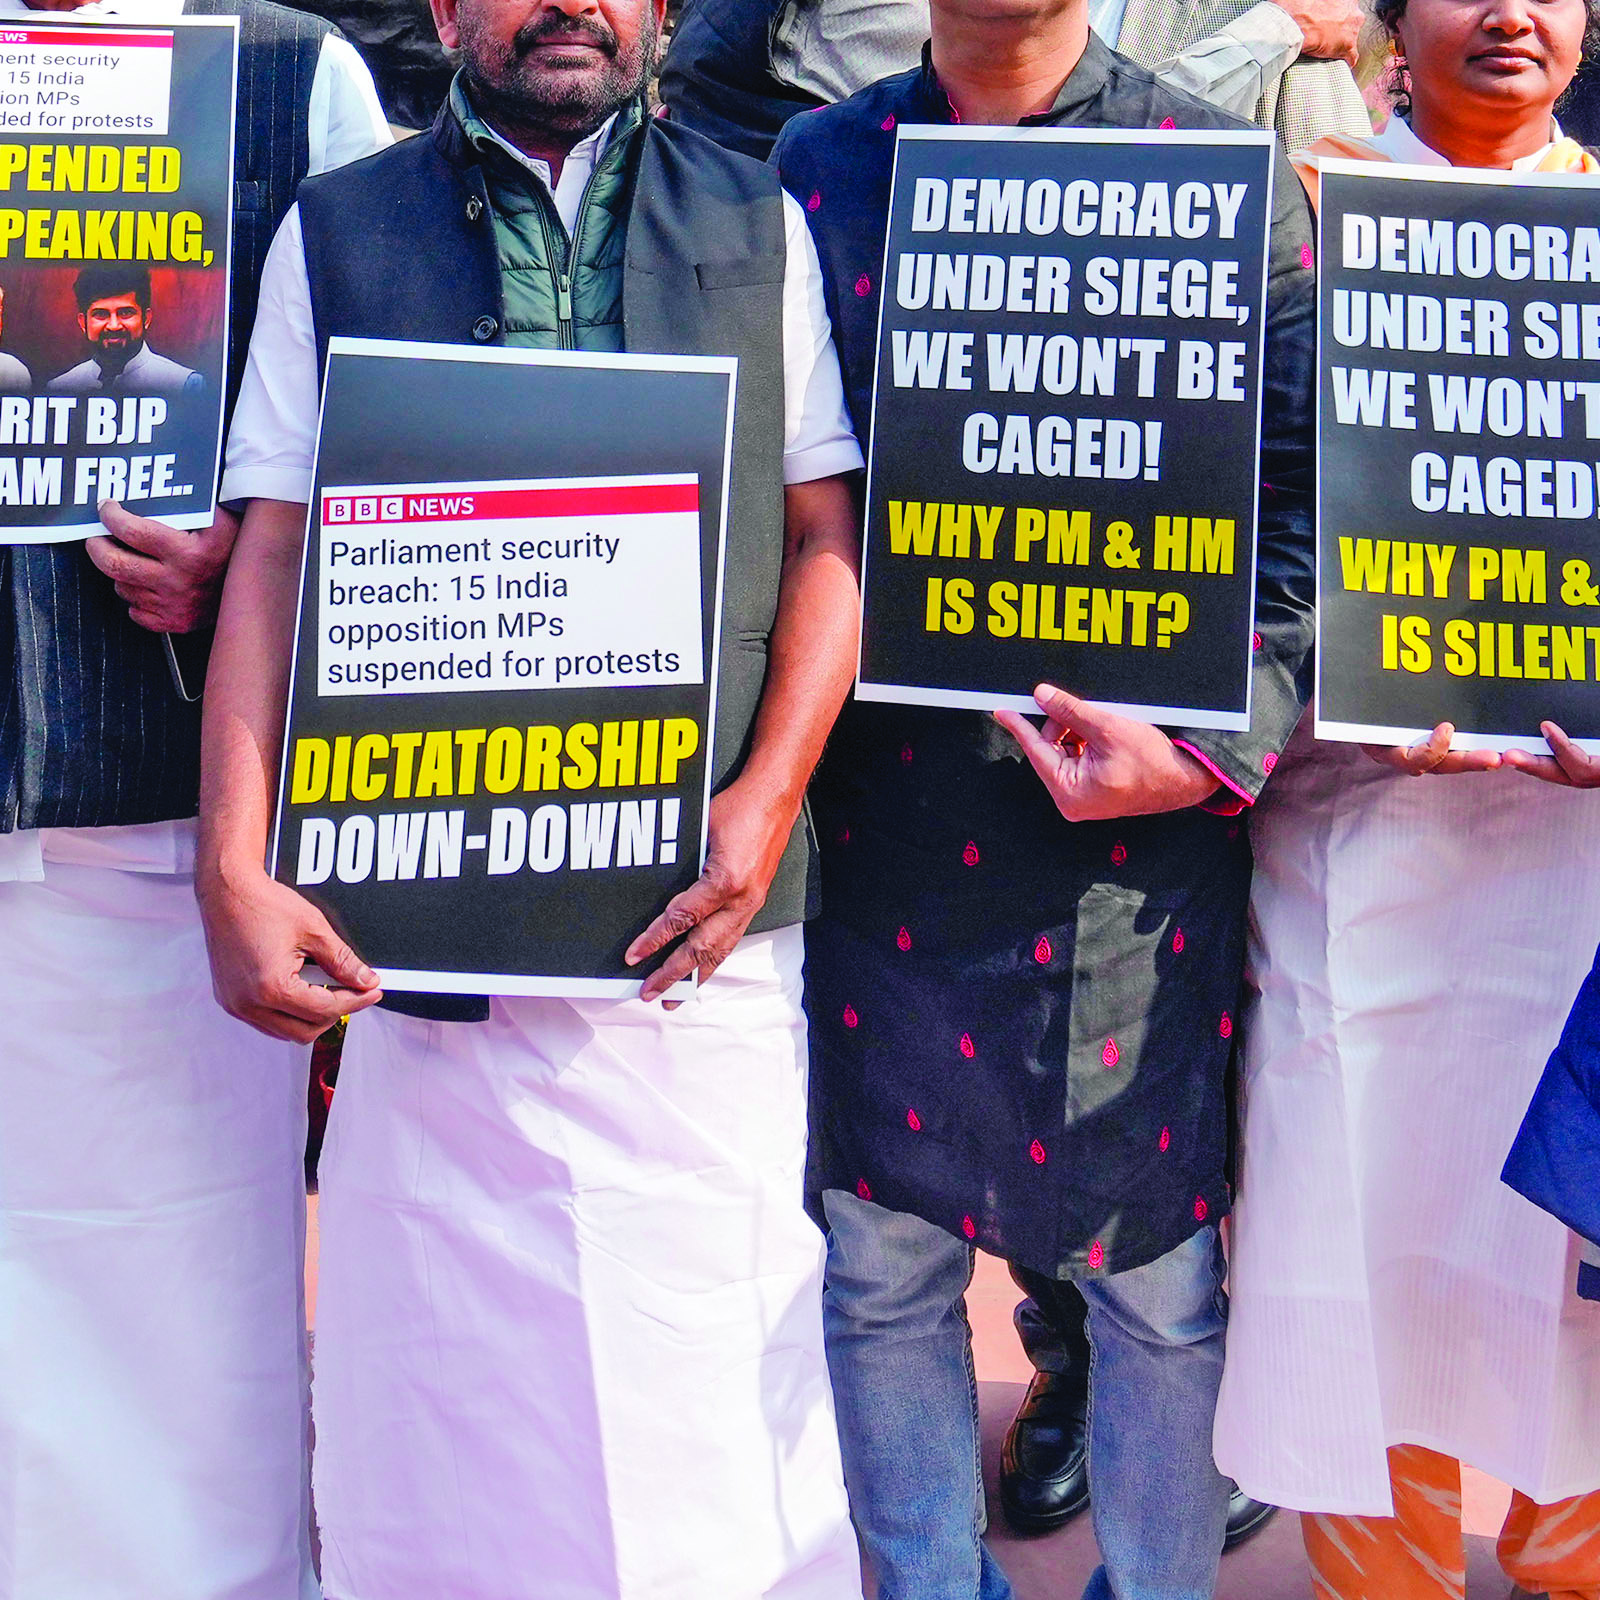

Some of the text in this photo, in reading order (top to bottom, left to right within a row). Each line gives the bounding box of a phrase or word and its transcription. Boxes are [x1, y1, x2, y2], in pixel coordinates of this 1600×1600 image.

[7, 71, 31, 84] 15
[37, 71, 85, 85] India
[42, 53, 121, 70] security
[36, 91, 80, 106] MPs
[38, 112, 67, 127] for
[72, 114, 154, 130] protests
[911, 177, 1249, 239] DEMOCRACY
[896, 253, 1250, 326] UNDER SIEGE,
[1332, 288, 1509, 357] UNDER
[891, 330, 1246, 402] WE WON'T BE
[86, 397, 167, 445] BJP
[1331, 366, 1417, 430] WE
[962, 412, 1163, 481] CAGED!
[73, 453, 194, 506] FREE..
[331, 497, 475, 521] BBC NEWS
[329, 532, 620, 567] Parliament security
[887, 500, 1236, 575] WHY PM & HM
[329, 572, 568, 606] breach: 15 India
[1338, 536, 1458, 599] WHY
[1468, 546, 1547, 604] PM
[1560, 559, 1600, 607] &
[328, 612, 565, 650] opposition MPs
[925, 577, 1190, 648] IS SILENT?
[328, 648, 681, 688] suspended for protests
[1382, 614, 1433, 674] IS
[290, 717, 699, 805] DICTATORSHIP
[295, 797, 681, 886] DOWN-DOWN!
